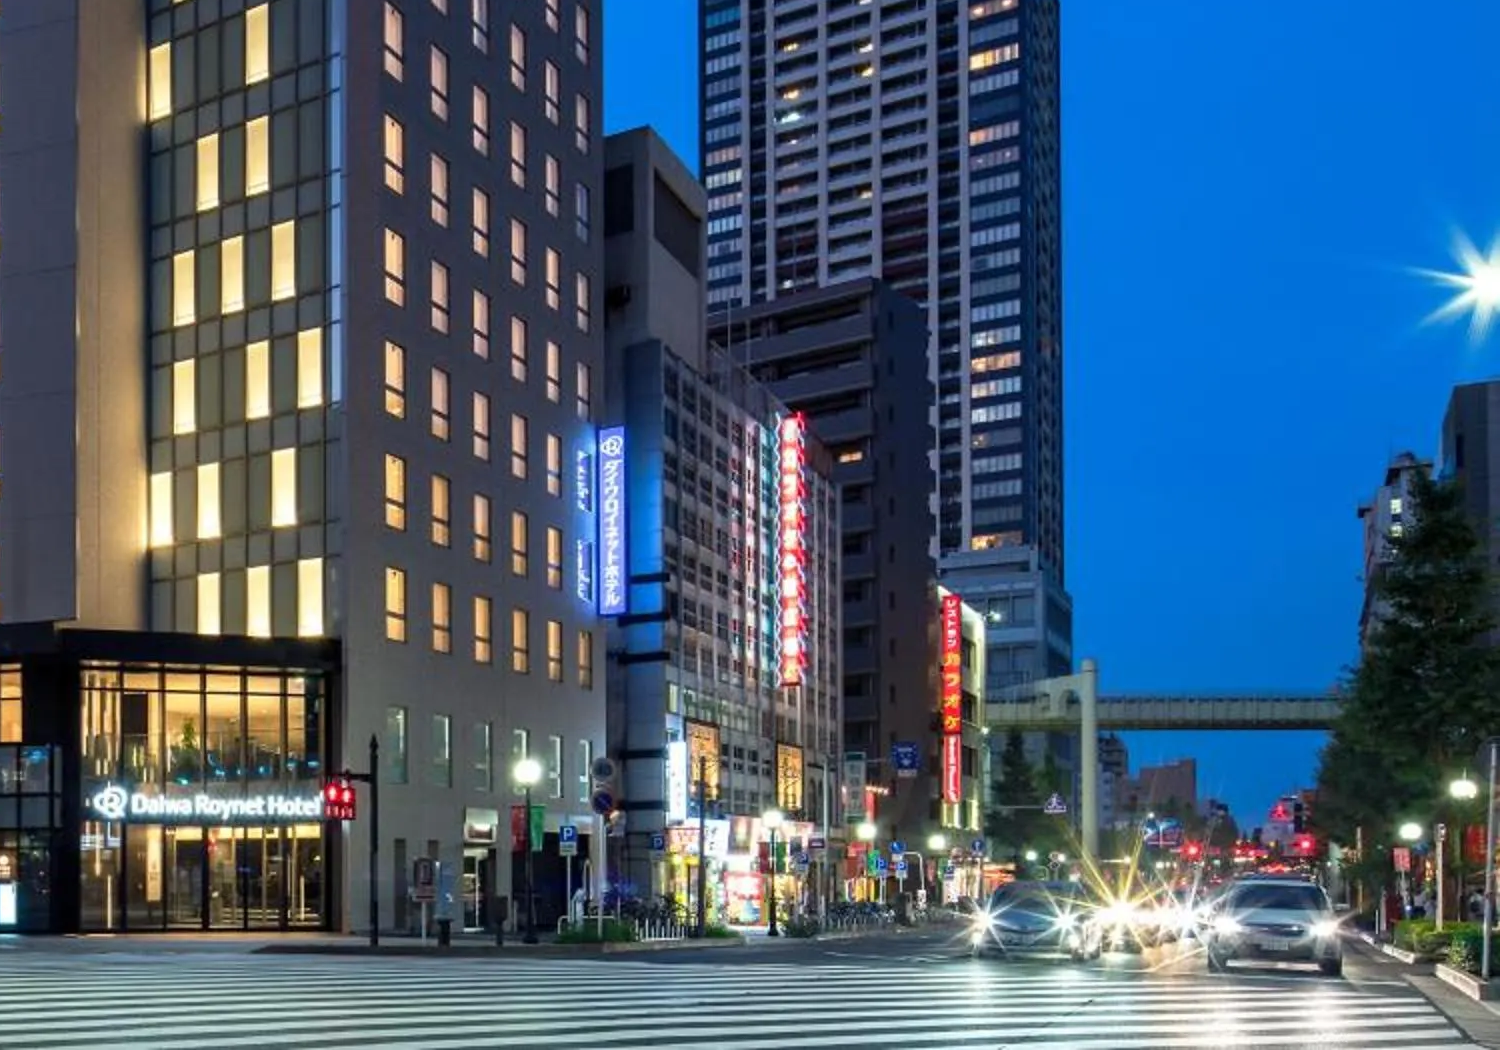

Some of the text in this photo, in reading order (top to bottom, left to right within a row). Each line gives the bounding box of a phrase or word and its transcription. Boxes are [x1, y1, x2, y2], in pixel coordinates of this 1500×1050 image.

[603, 459, 622, 607] ダイワロイネットホテル
[130, 795, 192, 816] Daiwa
[196, 795, 264, 820] Roynet
[267, 791, 324, 816] Hotel
